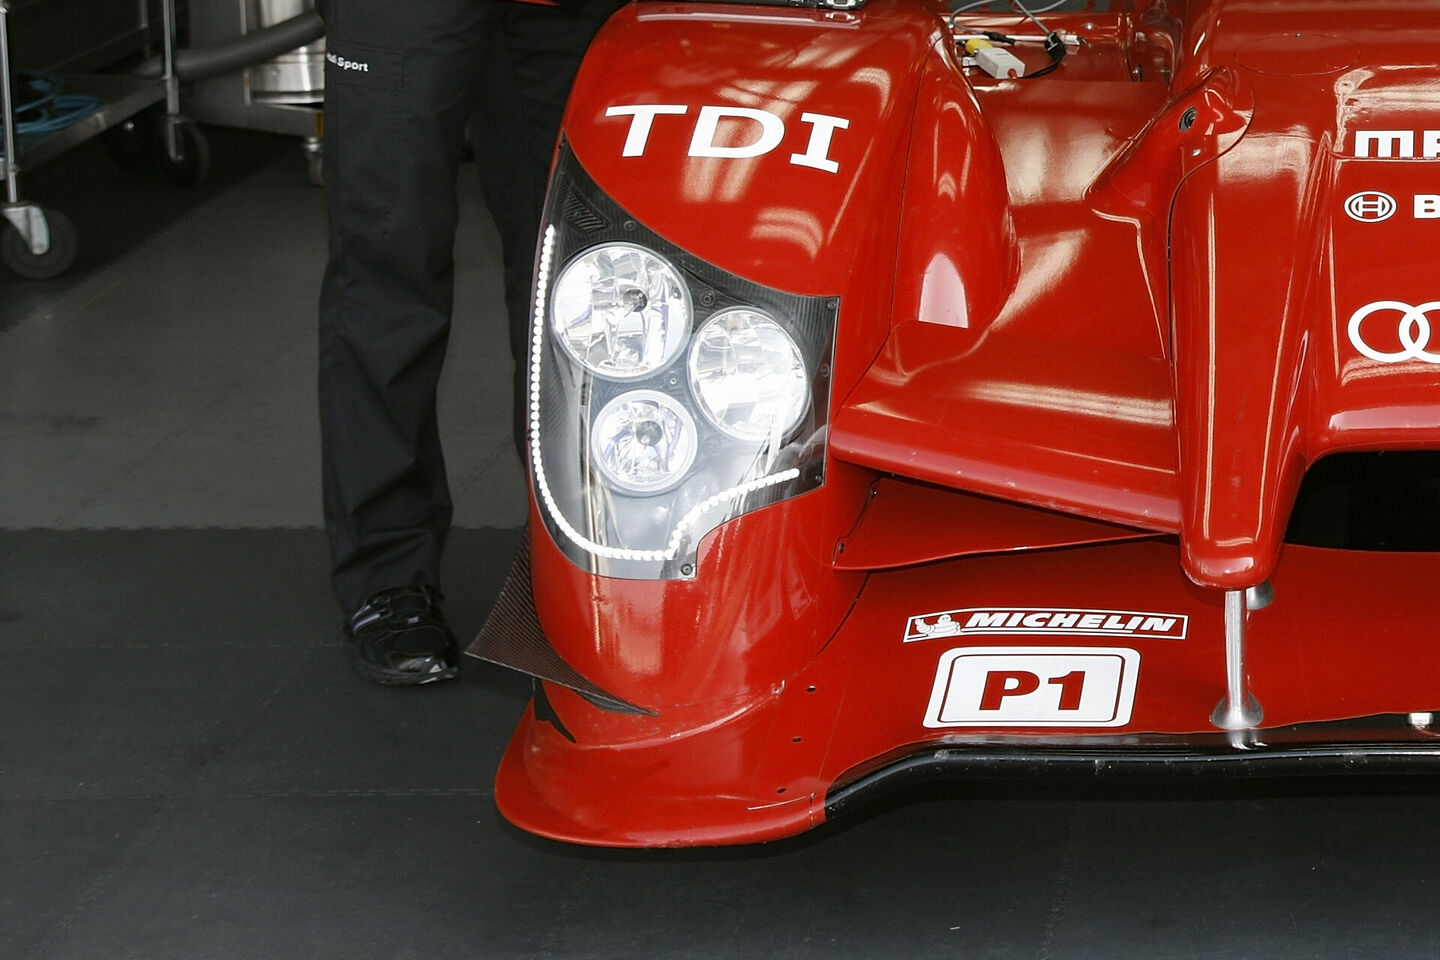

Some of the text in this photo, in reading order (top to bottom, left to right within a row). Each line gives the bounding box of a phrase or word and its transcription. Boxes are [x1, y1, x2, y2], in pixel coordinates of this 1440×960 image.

[338, 56, 369, 72] Sport
[605, 104, 850, 174] TDI
[966, 612, 1176, 632] MICHELIN
[979, 670, 1086, 711] P1
